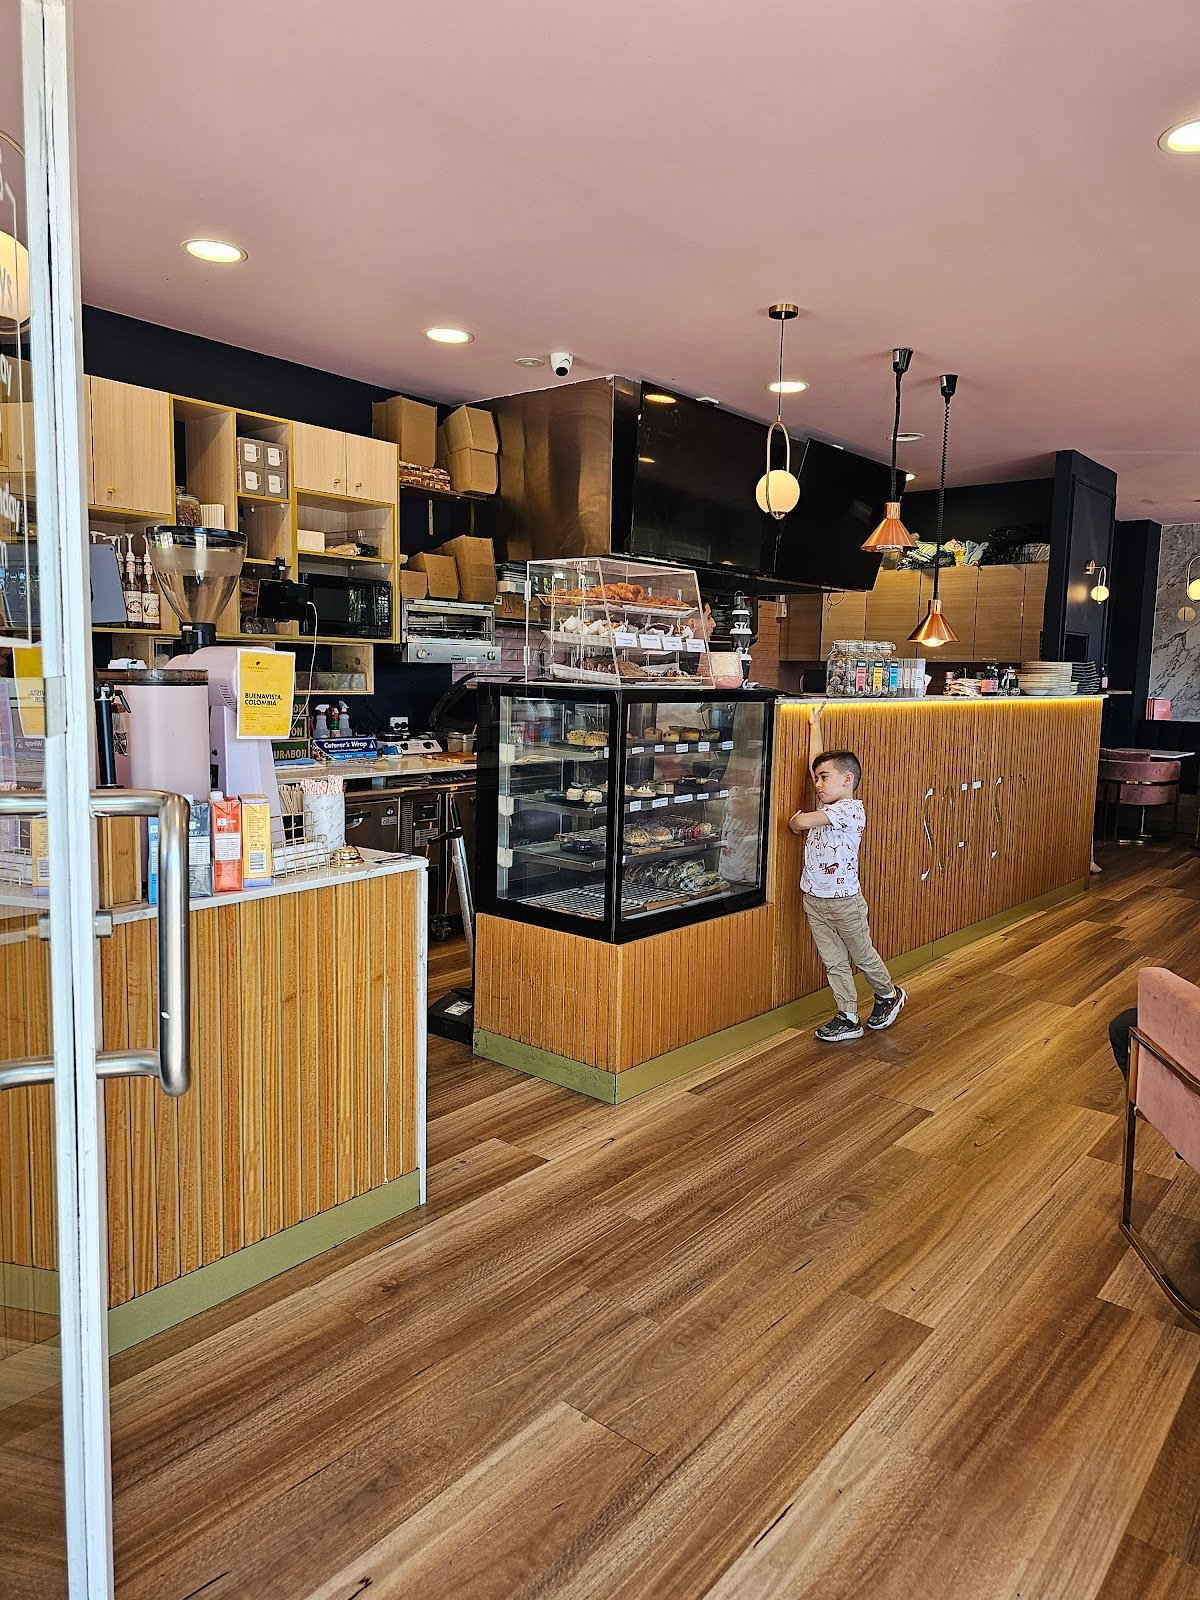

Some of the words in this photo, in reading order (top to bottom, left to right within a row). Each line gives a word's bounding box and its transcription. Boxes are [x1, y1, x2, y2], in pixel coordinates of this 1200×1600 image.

[245, 692, 283, 701] BUENAVISTA,
[324, 741, 351, 749] Caterer's
[351, 740, 368, 749] Wrap
[834, 890, 850, 898] AIR
